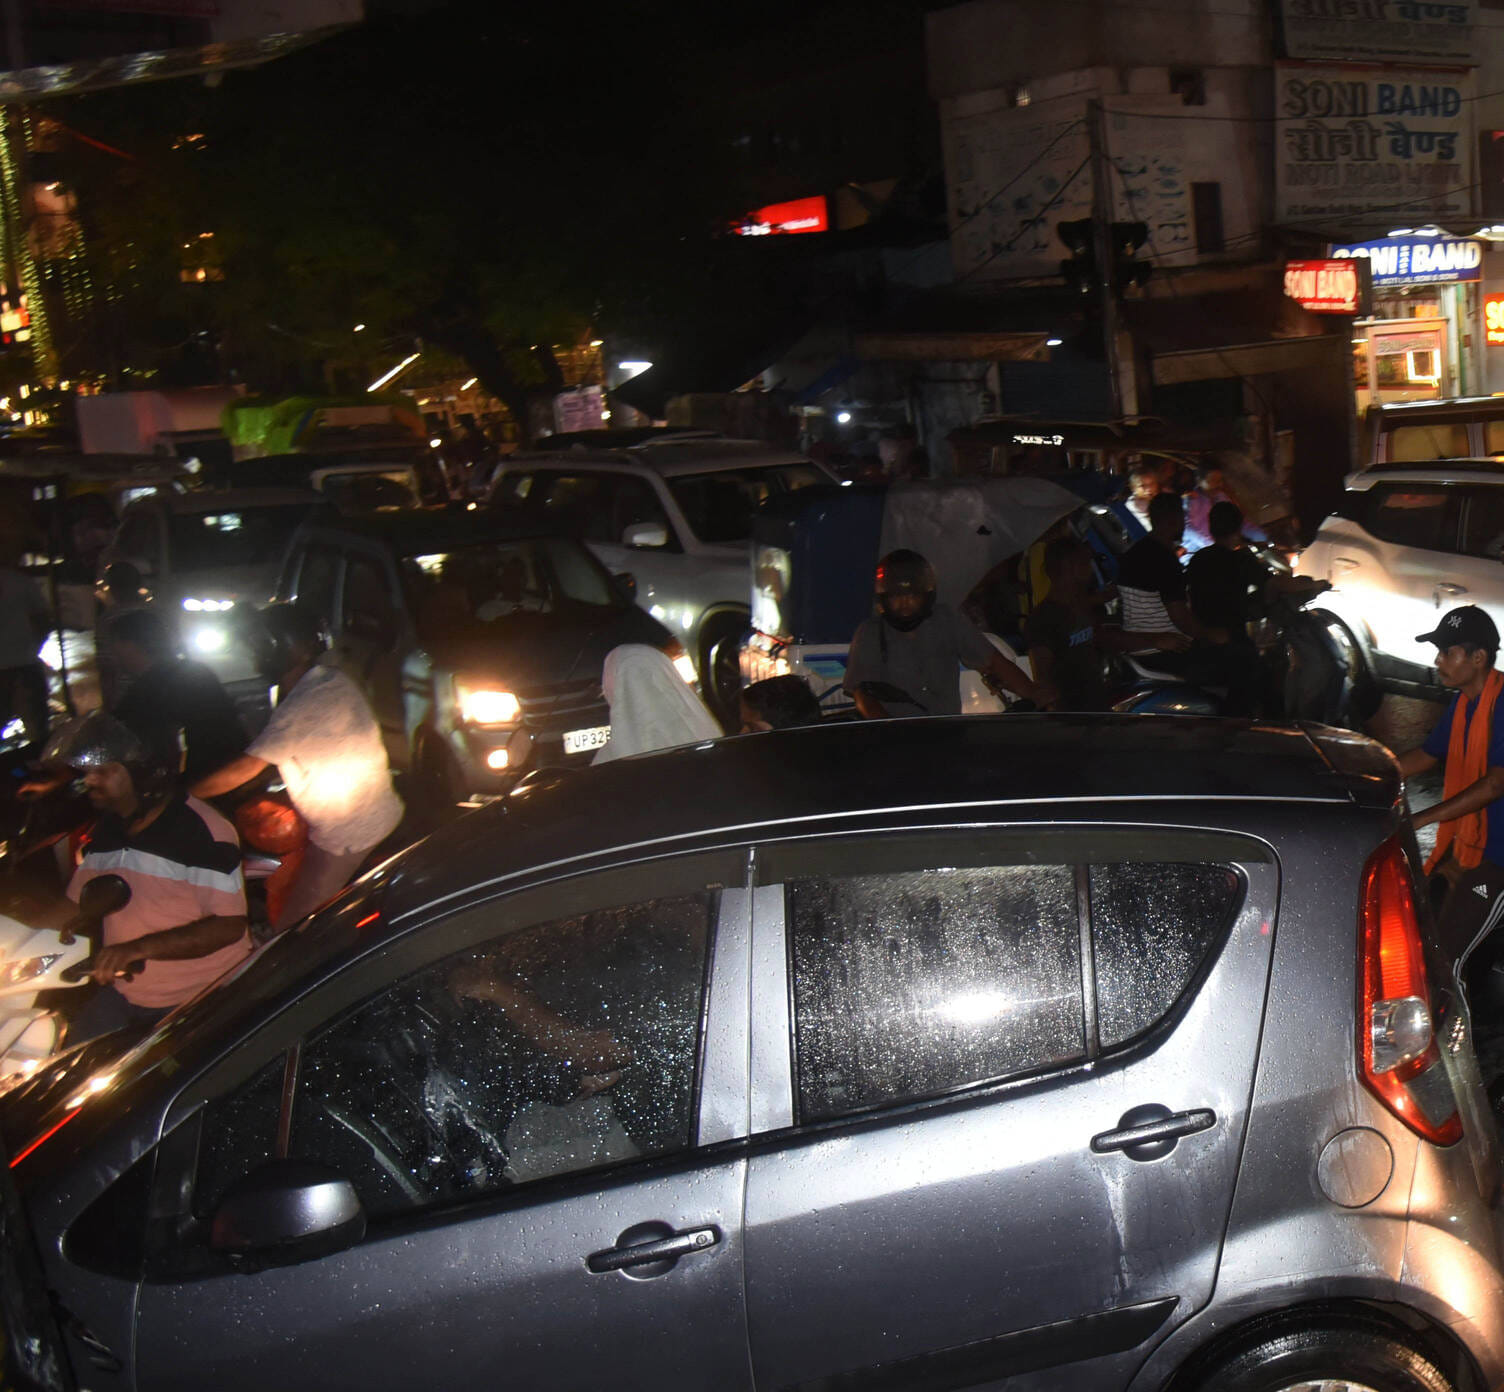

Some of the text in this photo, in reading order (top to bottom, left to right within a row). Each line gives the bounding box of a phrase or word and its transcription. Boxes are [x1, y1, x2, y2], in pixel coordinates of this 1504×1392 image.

[1284, 79, 1461, 118] SONI BAND
[1411, 242, 1482, 273] BAND
[1284, 270, 1357, 300] SONI BAND
